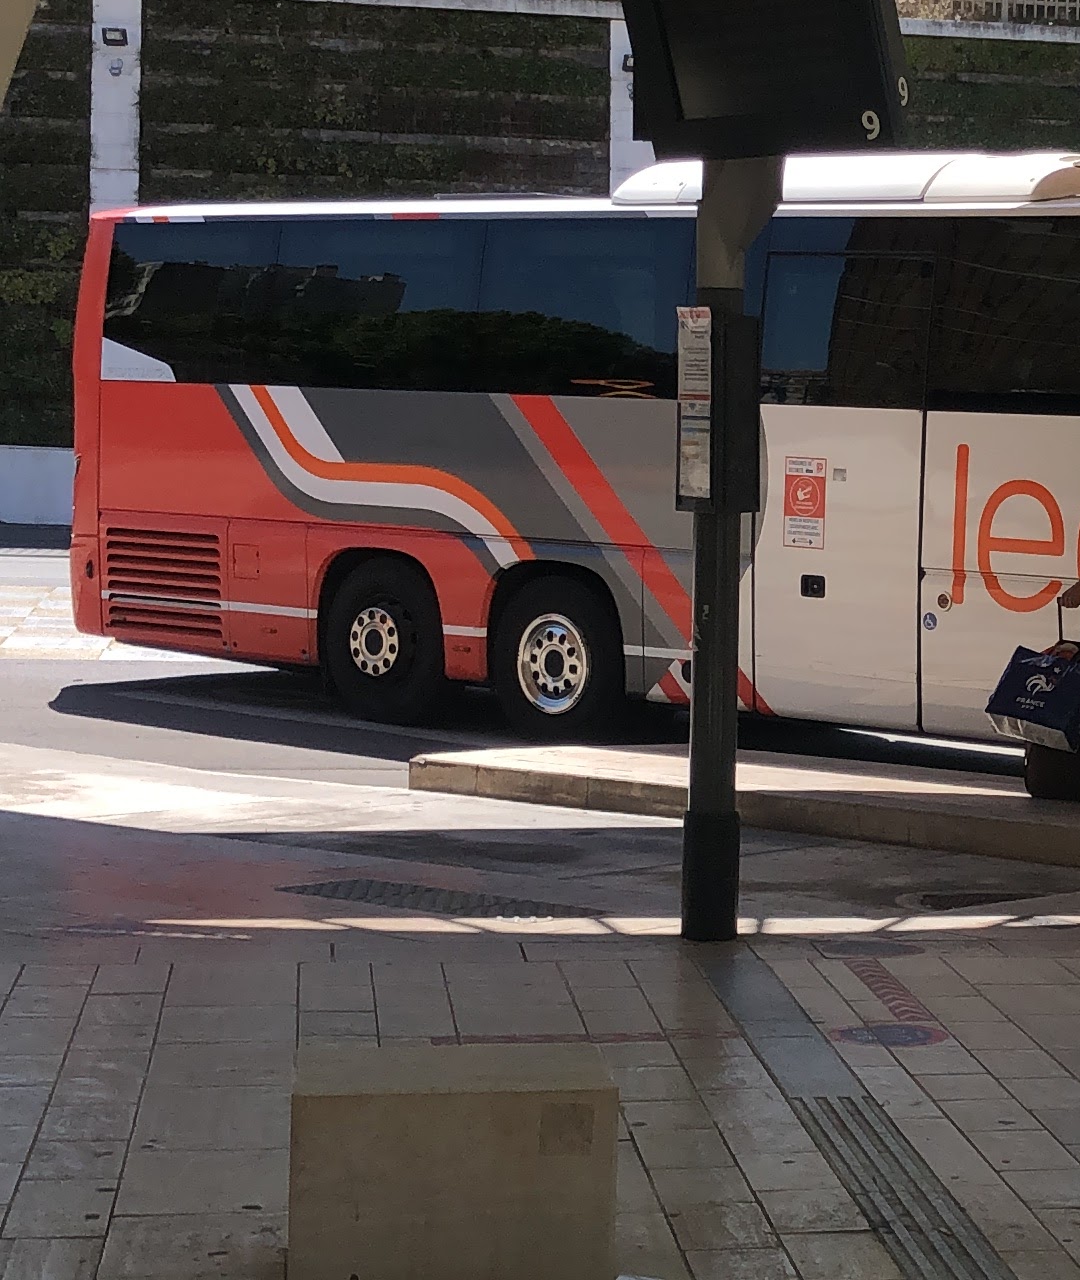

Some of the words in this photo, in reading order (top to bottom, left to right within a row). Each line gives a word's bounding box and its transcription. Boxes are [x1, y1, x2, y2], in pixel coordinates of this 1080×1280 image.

[898, 76, 908, 107] 9
[861, 110, 880, 140] 9
[1015, 696, 1046, 708] FRANCE
